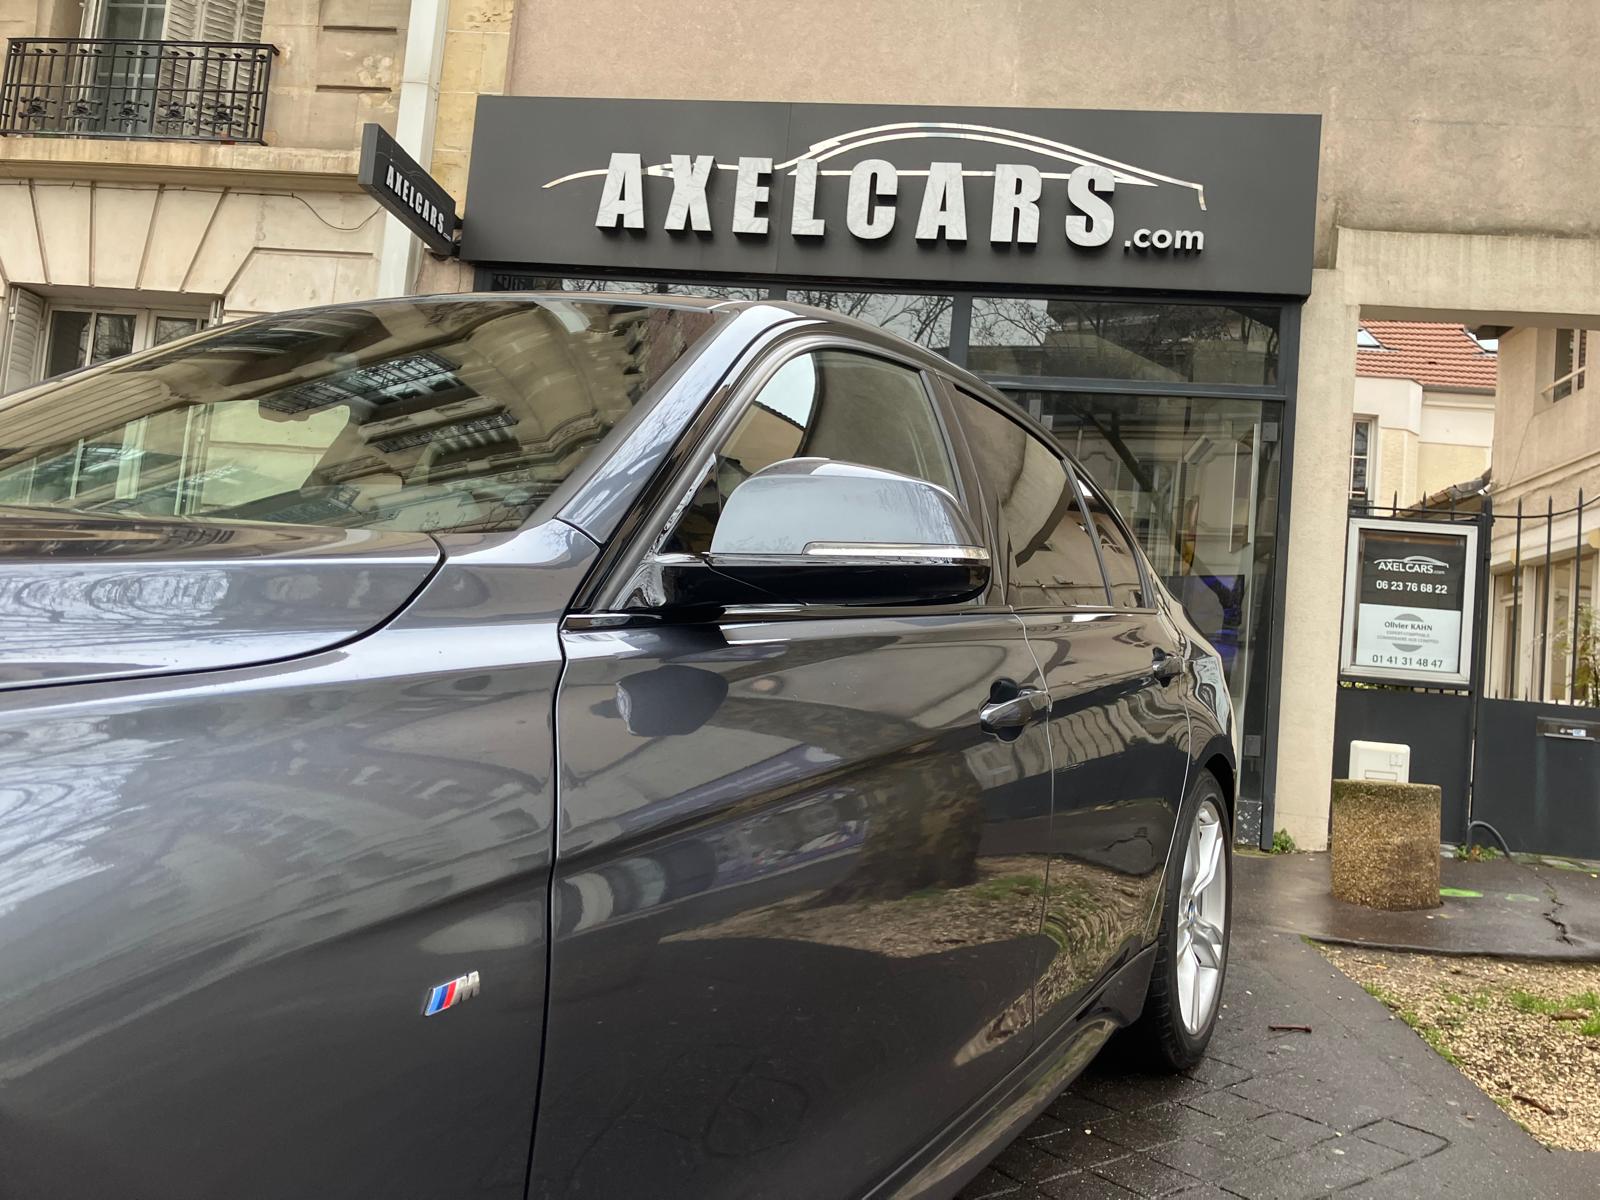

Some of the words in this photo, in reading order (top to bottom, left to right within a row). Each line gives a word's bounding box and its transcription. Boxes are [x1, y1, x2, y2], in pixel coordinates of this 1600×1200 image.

[385, 165, 445, 234] AXELCARS
[594, 151, 1116, 248] AXELCARS
[1124, 226, 1205, 251] .com
[1376, 580, 1388, 589] 06
[1391, 581, 1403, 590] 23
[1406, 582, 1418, 592] 76
[1420, 583, 1432, 592] 68
[1435, 584, 1448, 594] 22
[1372, 654, 1382, 664] 01
[1387, 656, 1398, 664] 41
[1402, 656, 1412, 666] 31
[1416, 658, 1428, 667] 48
[1431, 660, 1443, 668] 47
